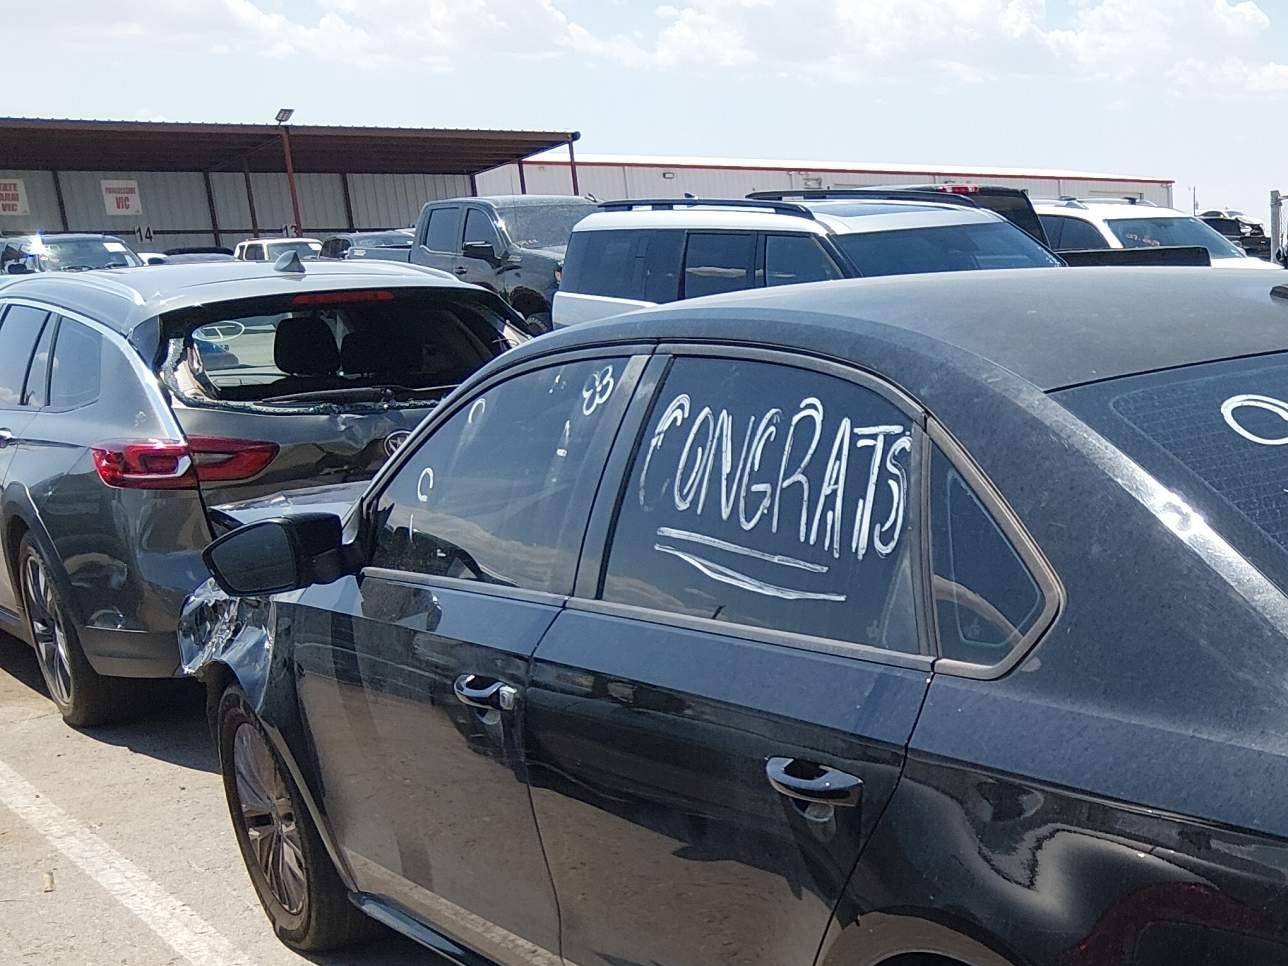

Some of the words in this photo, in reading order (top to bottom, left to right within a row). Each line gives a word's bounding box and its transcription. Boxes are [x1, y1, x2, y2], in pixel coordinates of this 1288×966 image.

[115, 197, 130, 209] VIC
[136, 227, 153, 241] 14
[638, 393, 912, 560] CONGRATS
